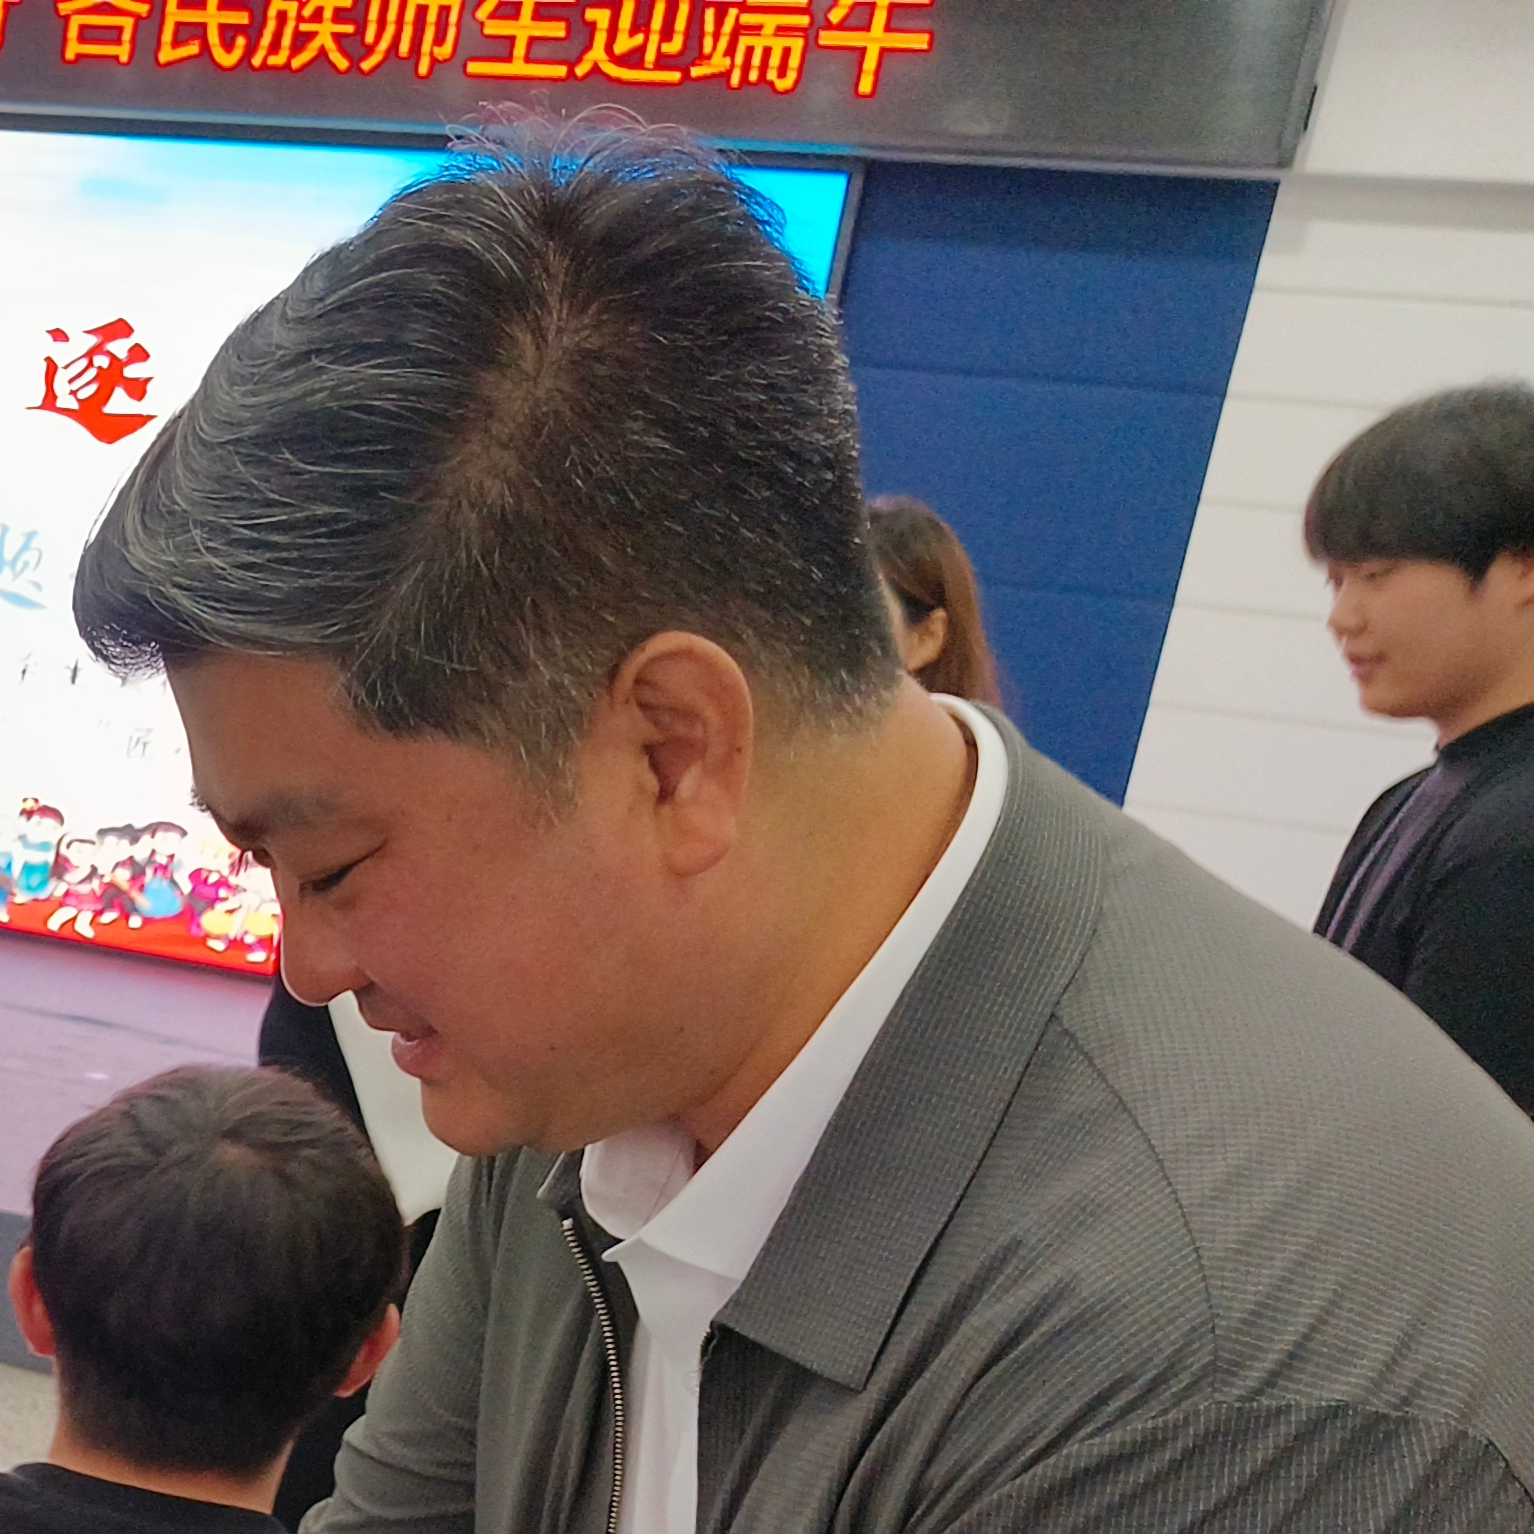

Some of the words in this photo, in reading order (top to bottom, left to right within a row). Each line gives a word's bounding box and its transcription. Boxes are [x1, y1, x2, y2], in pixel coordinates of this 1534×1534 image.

[56, 0, 935, 98] 各民族师生迎端午
[26, 318, 159, 444] 逐
